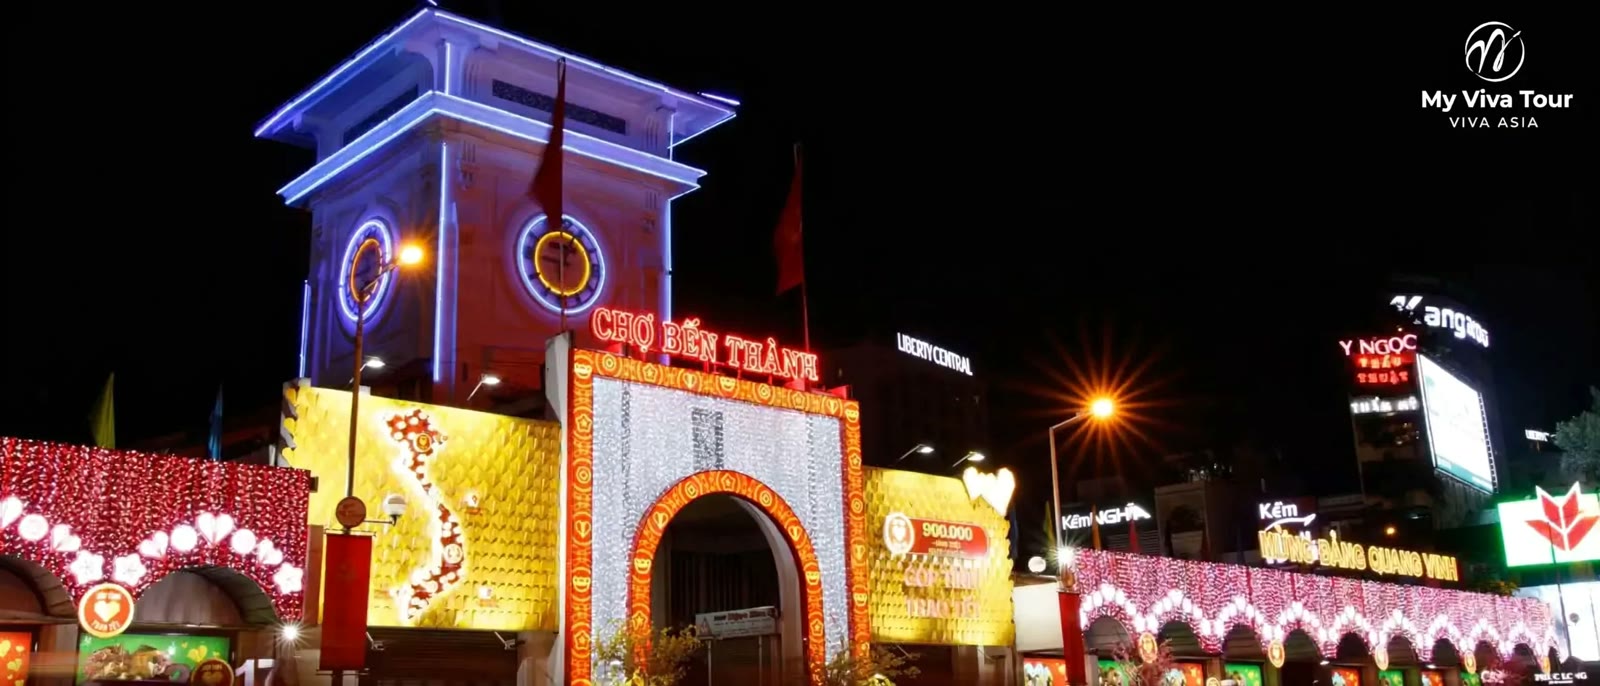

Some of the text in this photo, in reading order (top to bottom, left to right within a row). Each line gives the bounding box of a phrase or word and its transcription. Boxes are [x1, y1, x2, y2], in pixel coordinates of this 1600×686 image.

[592, 308, 819, 381] CHỢ BẾN THÀNH
[897, 332, 974, 377] LIBERTY CENTRAL
[922, 522, 973, 541] 900.000
[1368, 545, 1423, 577] QUANG
[1422, 552, 1458, 582] VINH
